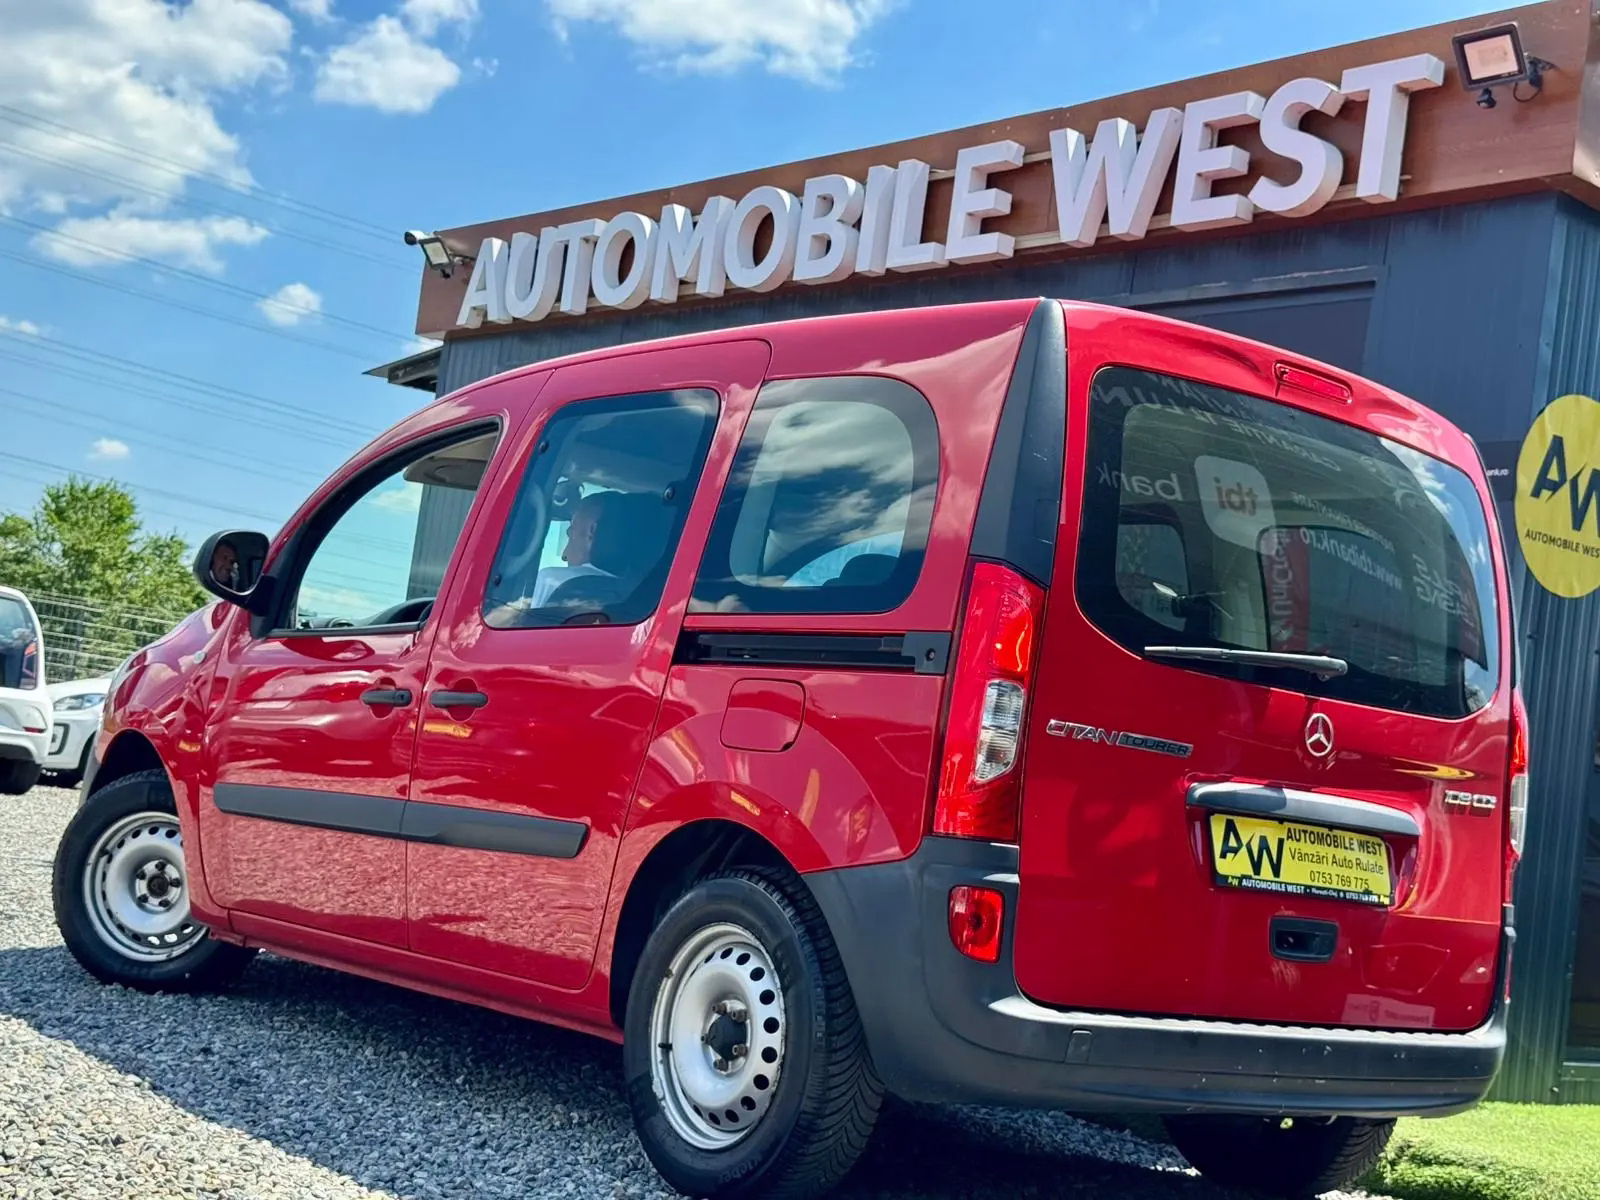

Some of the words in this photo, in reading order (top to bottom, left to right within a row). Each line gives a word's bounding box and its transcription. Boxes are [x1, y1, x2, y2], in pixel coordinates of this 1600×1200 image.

[456, 139, 1024, 329] AUTOMOBILE
[1049, 53, 1444, 249] WEST
[1525, 528, 1580, 553] AUTOMOBILE
[1581, 544, 1600, 559] WES
[1046, 719, 1118, 746] CITAN
[1120, 733, 1191, 756] TOURER
[1286, 827, 1355, 851] AUTOMOBILE
[1356, 839, 1382, 857] WEST
[1331, 853, 1354, 869] Auto
[1356, 857, 1384, 875] Rulate
[1241, 878, 1286, 892] AUTOMOBILE
[1286, 884, 1305, 894] WEST
[1310, 870, 1333, 885] 0753
[1335, 874, 1352, 888] 769
[1354, 876, 1370, 890] 775
